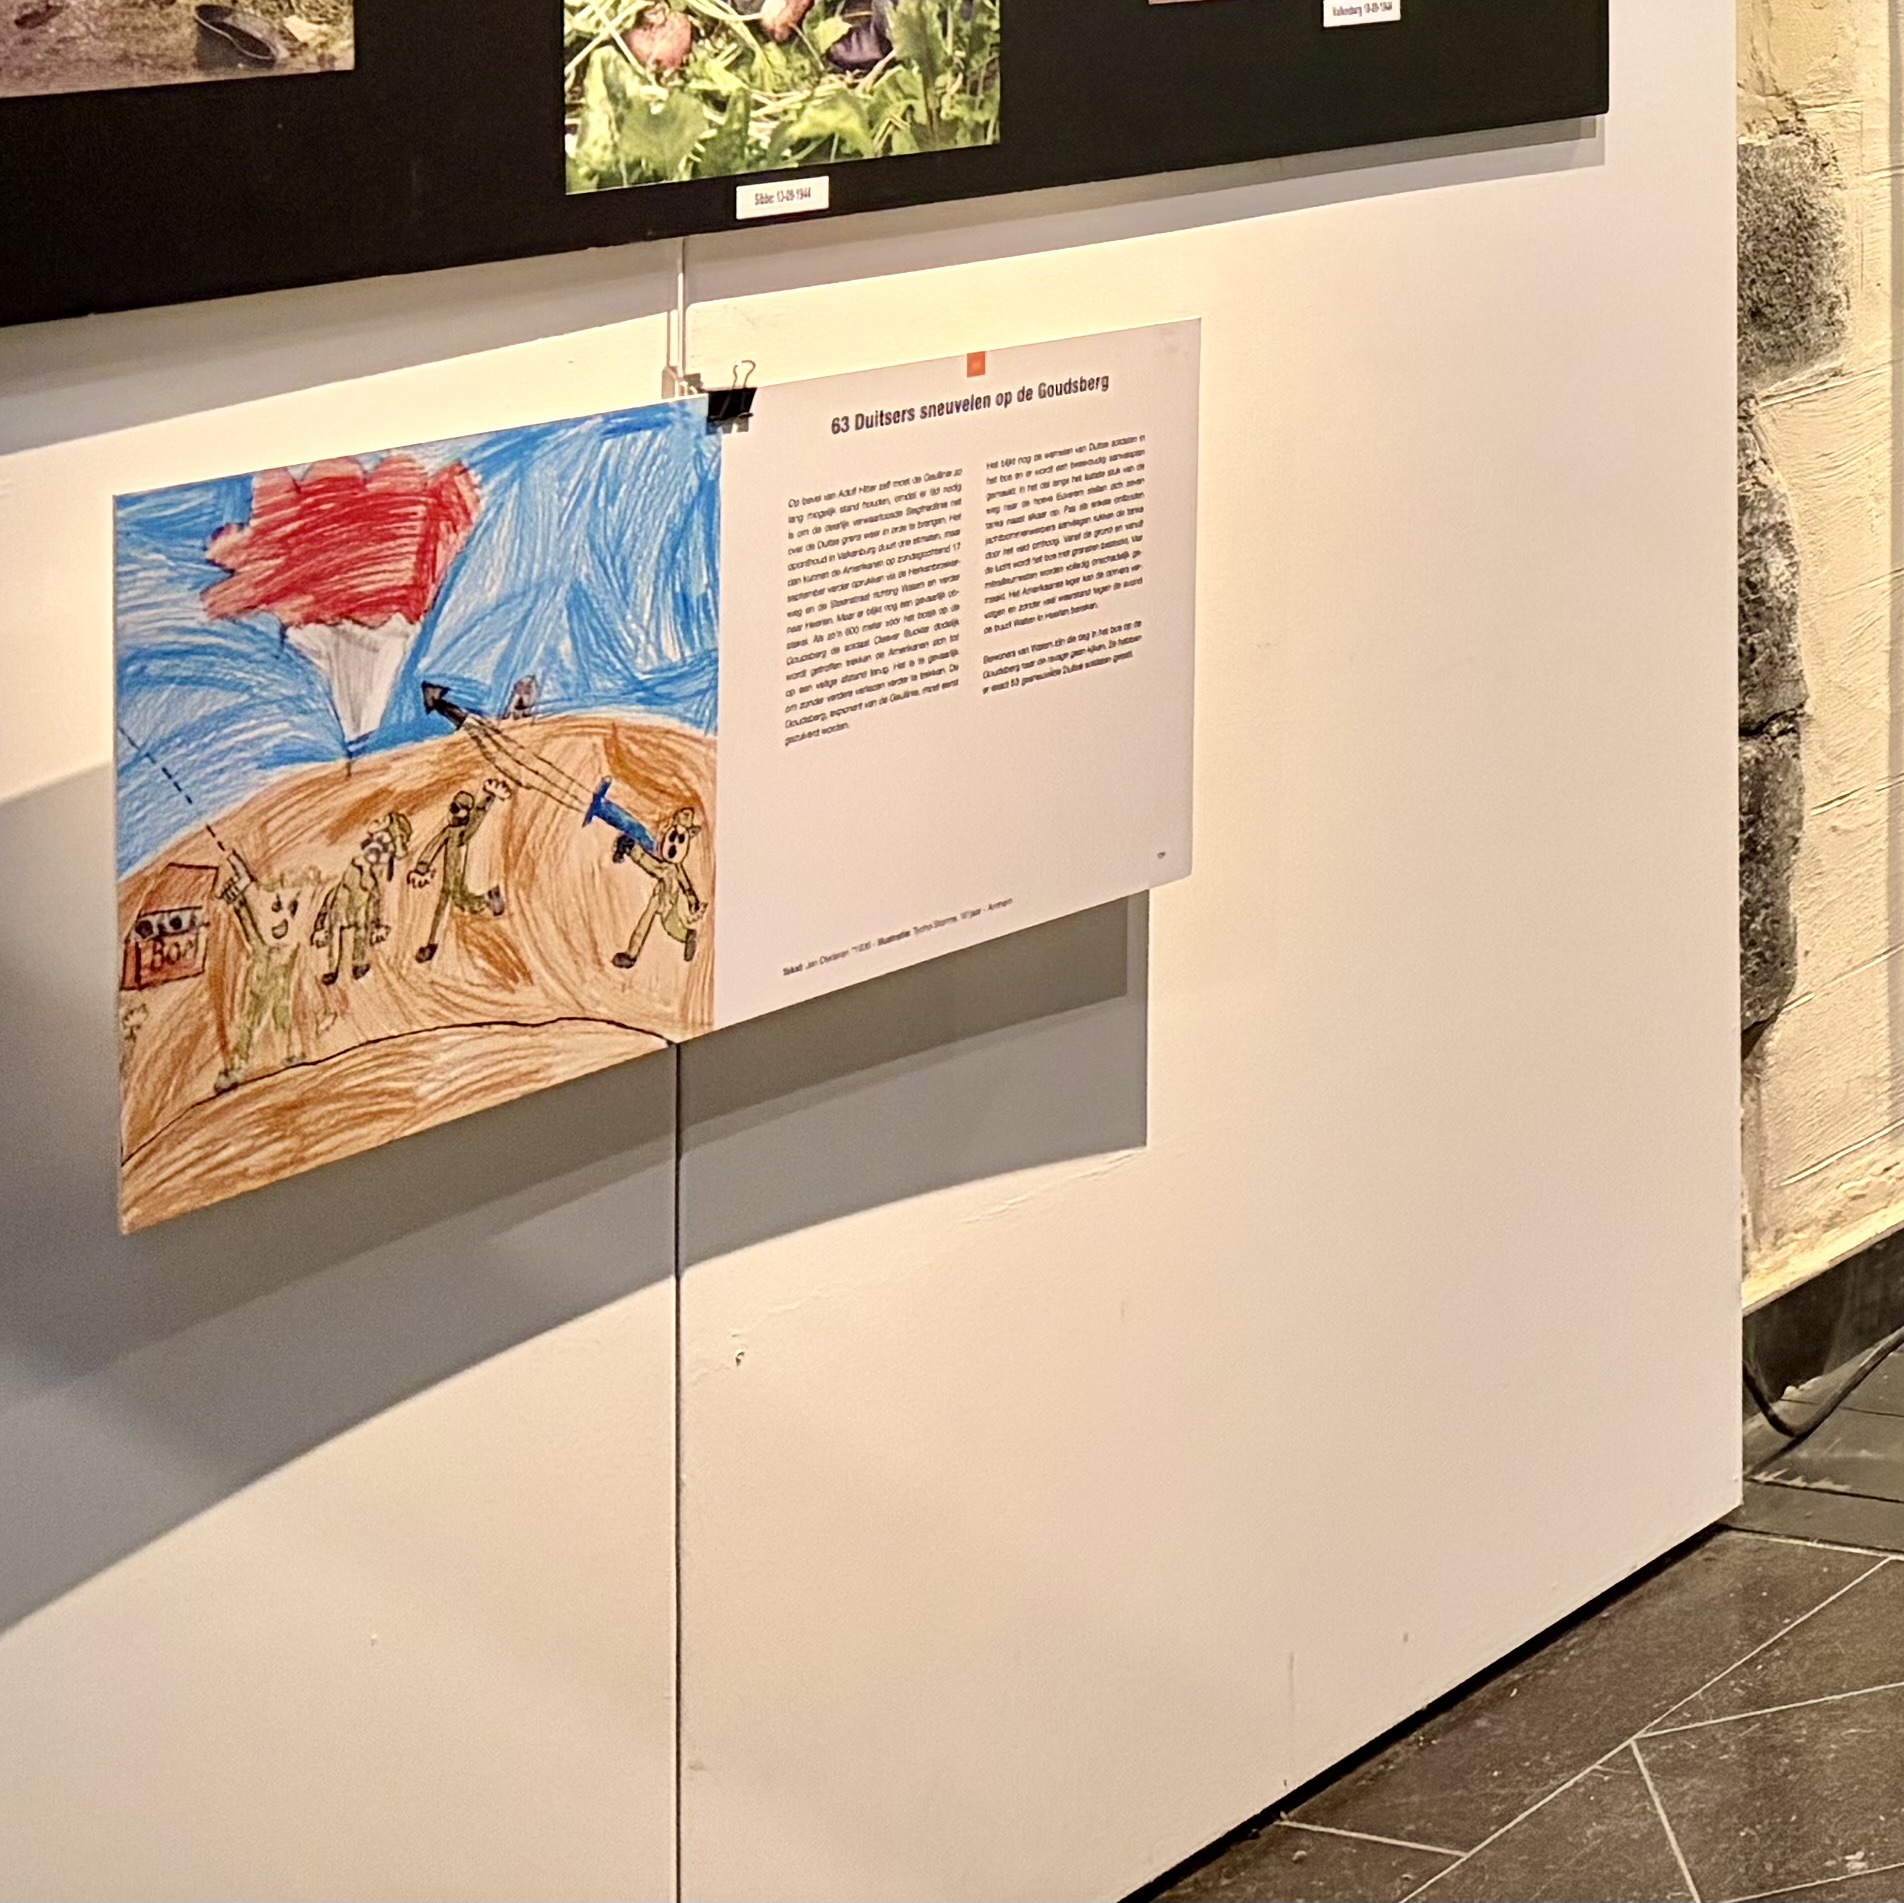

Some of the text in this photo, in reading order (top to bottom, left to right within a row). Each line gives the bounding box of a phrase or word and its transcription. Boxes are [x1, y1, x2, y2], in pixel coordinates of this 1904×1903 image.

[831, 375, 1109, 435] 63 Duitsers sneuvelen op de Goudsberg
[788, 498, 799, 507] Op
